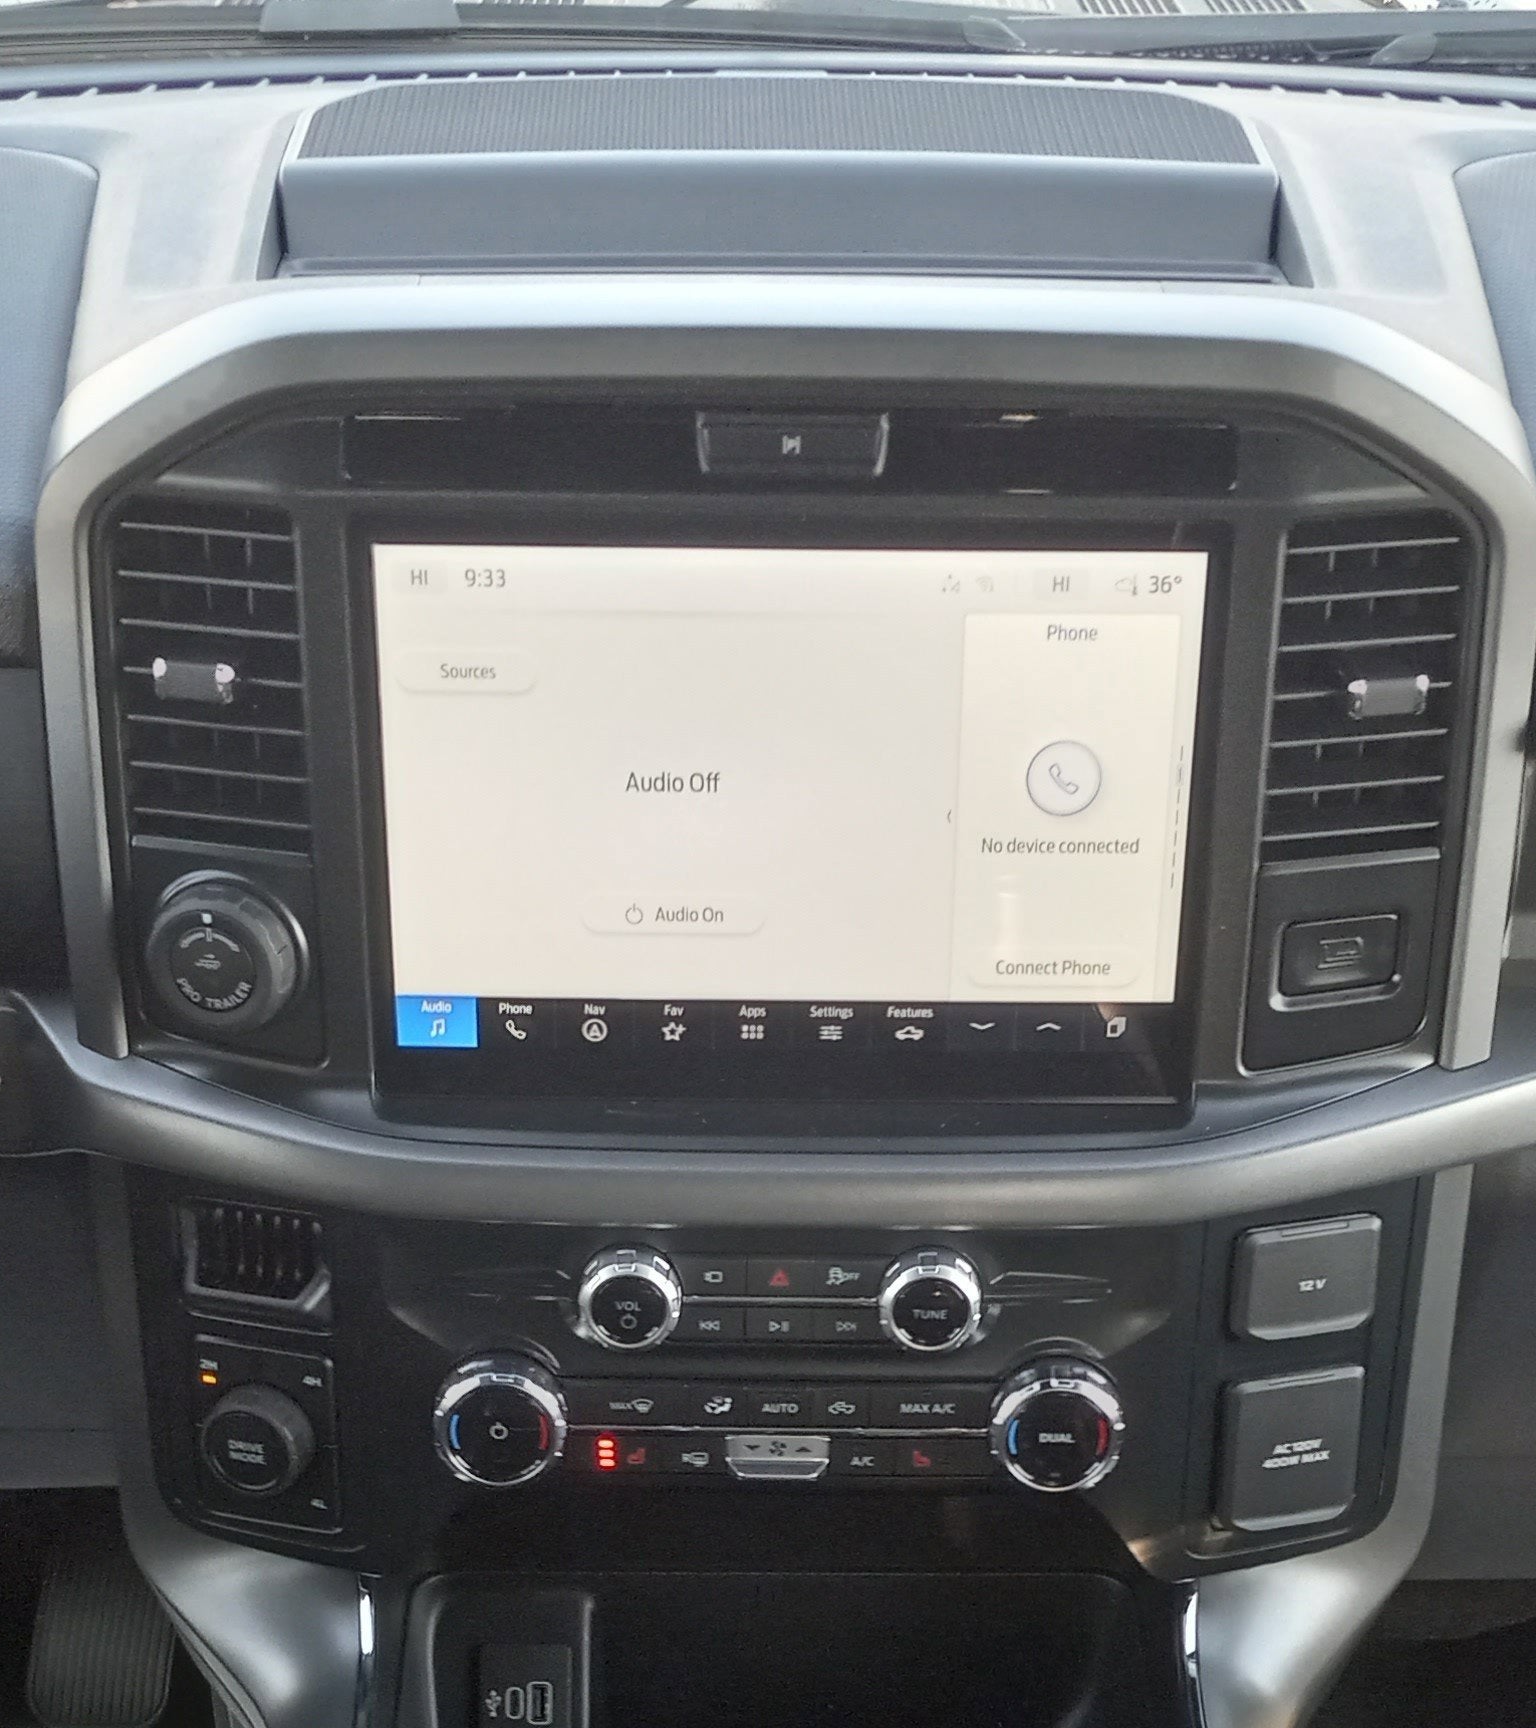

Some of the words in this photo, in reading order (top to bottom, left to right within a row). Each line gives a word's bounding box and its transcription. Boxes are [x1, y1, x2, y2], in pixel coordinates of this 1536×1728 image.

[410, 568, 428, 586] HI
[464, 568, 506, 588] 9:33
[1052, 575, 1071, 593] HI
[1046, 624, 1099, 642] Phone
[440, 663, 497, 679] Sources
[625, 771, 684, 793] Audio
[689, 772, 721, 793] Off
[981, 838, 1003, 854] No
[1006, 838, 1055, 854] device
[1058, 838, 1140, 854] connected
[655, 906, 699, 923] Audio
[702, 907, 724, 923] On
[995, 959, 1058, 975] Connect
[1061, 959, 1111, 975] Phone
[176, 978, 202, 1003] PRO
[204, 981, 253, 1009] TRAILER
[421, 1001, 452, 1013] Audio
[498, 1002, 533, 1015] Phone
[584, 1004, 606, 1015] Nav
[664, 1004, 684, 1017] Fav
[738, 1005, 766, 1019] Apps
[809, 1005, 853, 1020] Settings
[887, 1006, 933, 1018] Features
[1298, 1278, 1327, 1292] 12V
[616, 1301, 641, 1311] VOL
[913, 1309, 948, 1320] TUNE
[761, 1403, 799, 1414] AUTO
[899, 1403, 930, 1414] MAX
[931, 1404, 956, 1414] A/C
[1038, 1433, 1075, 1443] DUAL
[227, 1439, 265, 1454] DRIVE
[228, 1451, 268, 1465] MODE
[850, 1456, 875, 1466] A/C
[1261, 1454, 1301, 1469] 400W
[1300, 1450, 1331, 1464] MAX
